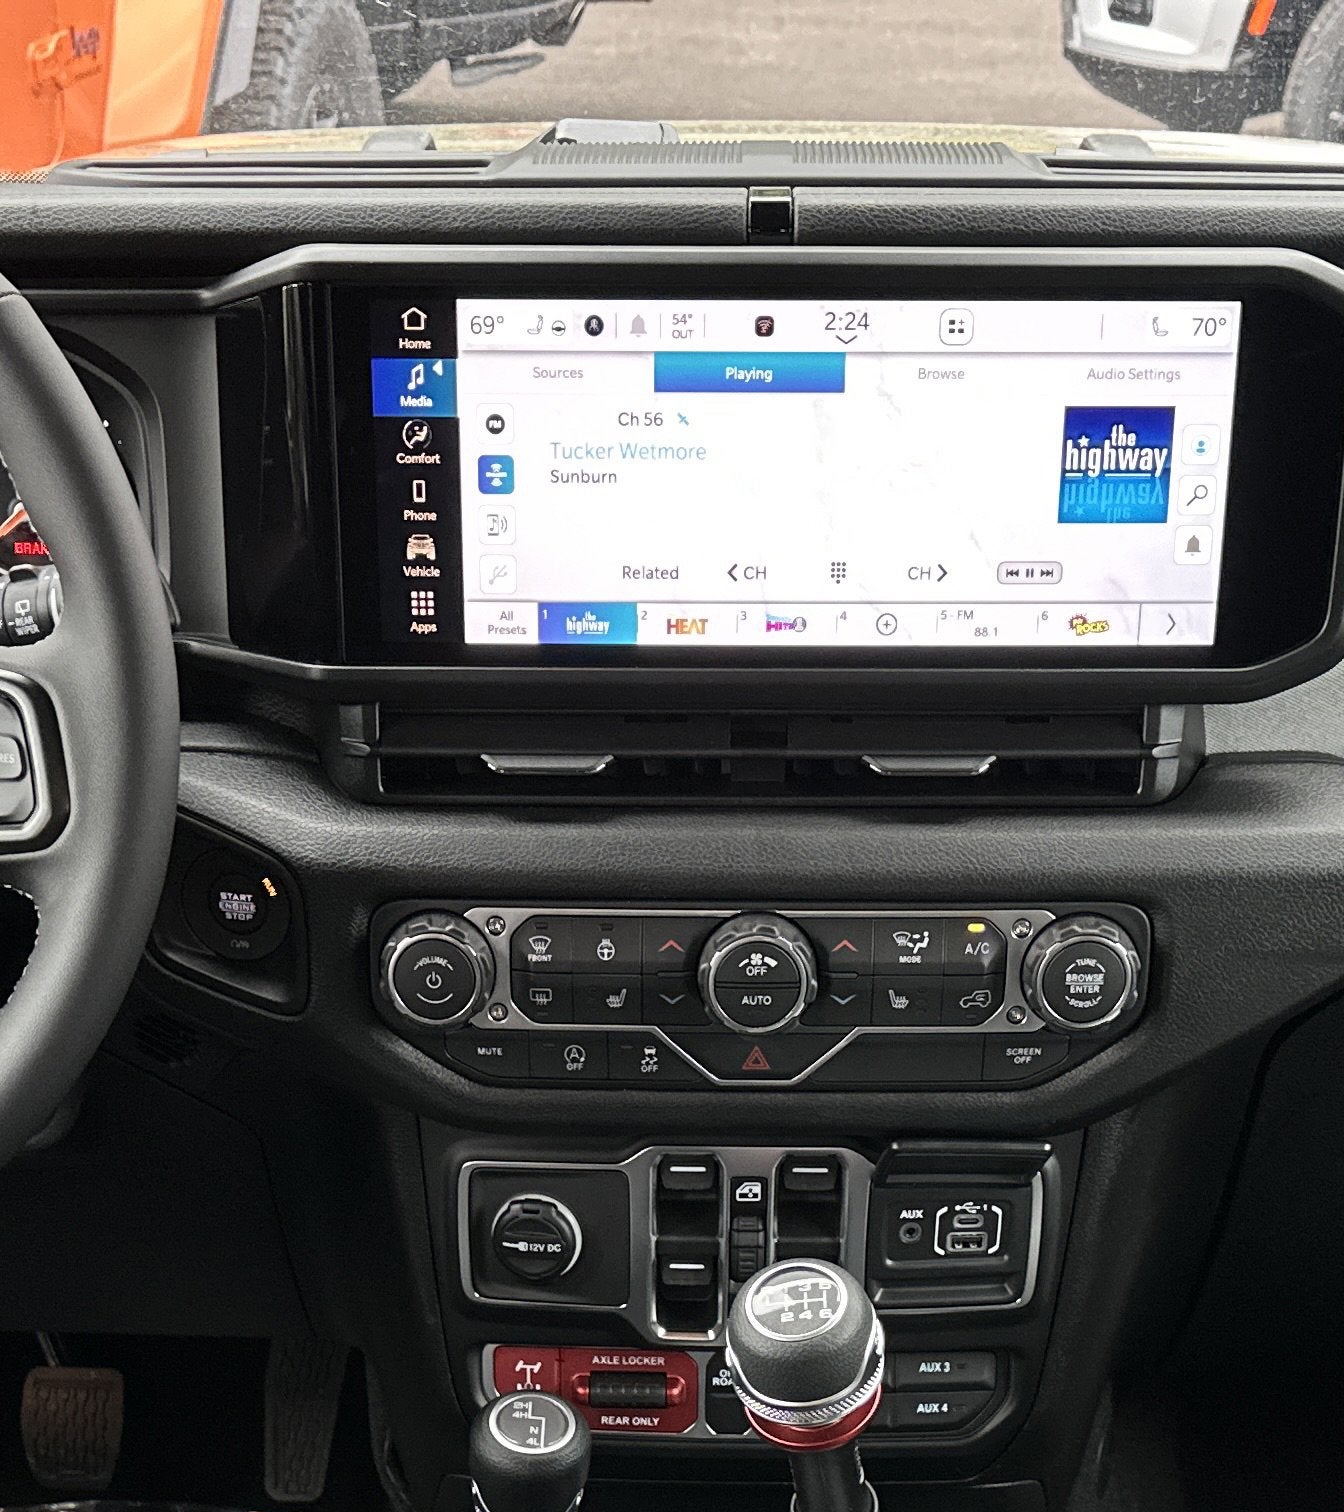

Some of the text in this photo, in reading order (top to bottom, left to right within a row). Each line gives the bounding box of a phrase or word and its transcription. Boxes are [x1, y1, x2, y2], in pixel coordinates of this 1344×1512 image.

[470, 316, 504, 334] 69°
[825, 312, 869, 330] 2:24
[1192, 318, 1227, 336] 70°
[672, 329, 694, 339] OUT
[399, 338, 431, 349] Home
[533, 367, 584, 379] Sources
[725, 367, 773, 382] Playing
[918, 368, 965, 380] Browse
[1087, 368, 1181, 383] Audio Settings
[400, 395, 432, 407] Media
[618, 413, 663, 426] Ch 56
[1111, 424, 1136, 447] the
[551, 442, 706, 460] Tucker Wetmore
[396, 452, 441, 464] Comfort
[1065, 439, 1168, 478] highway
[550, 469, 617, 484] Sunburn
[403, 510, 437, 521] Phone
[403, 565, 440, 577] Vehicle
[622, 566, 679, 580] Related
[743, 566, 767, 580] CH
[908, 566, 931, 580] CH
[499, 610, 514, 621] All
[957, 610, 974, 620] FM
[410, 622, 437, 634] Apps
[487, 624, 527, 635] Presets
[667, 618, 708, 635] HEAT
[974, 627, 998, 637] 88.1
[220, 892, 253, 901] START
[219, 902, 256, 912] ENGINE
[225, 912, 253, 921] STOP
[965, 942, 989, 955] A/C
[417, 956, 448, 968] VOLUME
[527, 954, 552, 962] FRONT
[1076, 958, 1097, 967] TUNE
[746, 966, 768, 977] OFF
[1065, 973, 1104, 982] BROWSE
[1070, 985, 1100, 994] ENTER
[741, 995, 772, 1006] AUTO
[1068, 997, 1100, 1009] SCROLL
[477, 1048, 503, 1056] MUTE
[1006, 1048, 1041, 1056] SCREEN
[1014, 1056, 1032, 1064] OFF
[567, 1062, 584, 1071] OFF
[641, 1064, 658, 1073] OFF
[899, 1209, 923, 1219] AUX
[528, 1244, 561, 1252] 12V DC
[781, 1312, 794, 1322] 2
[799, 1310, 812, 1320] 4
[819, 1308, 832, 1318] 6
[592, 1356, 665, 1366] AXLE LOCKER
[918, 1362, 950, 1373] AUX 3
[916, 1402, 948, 1413] AUX 4
[601, 1416, 660, 1426] REAR ONLY
[529, 1426, 539, 1434] N
[526, 1437, 540, 1445] 4L
